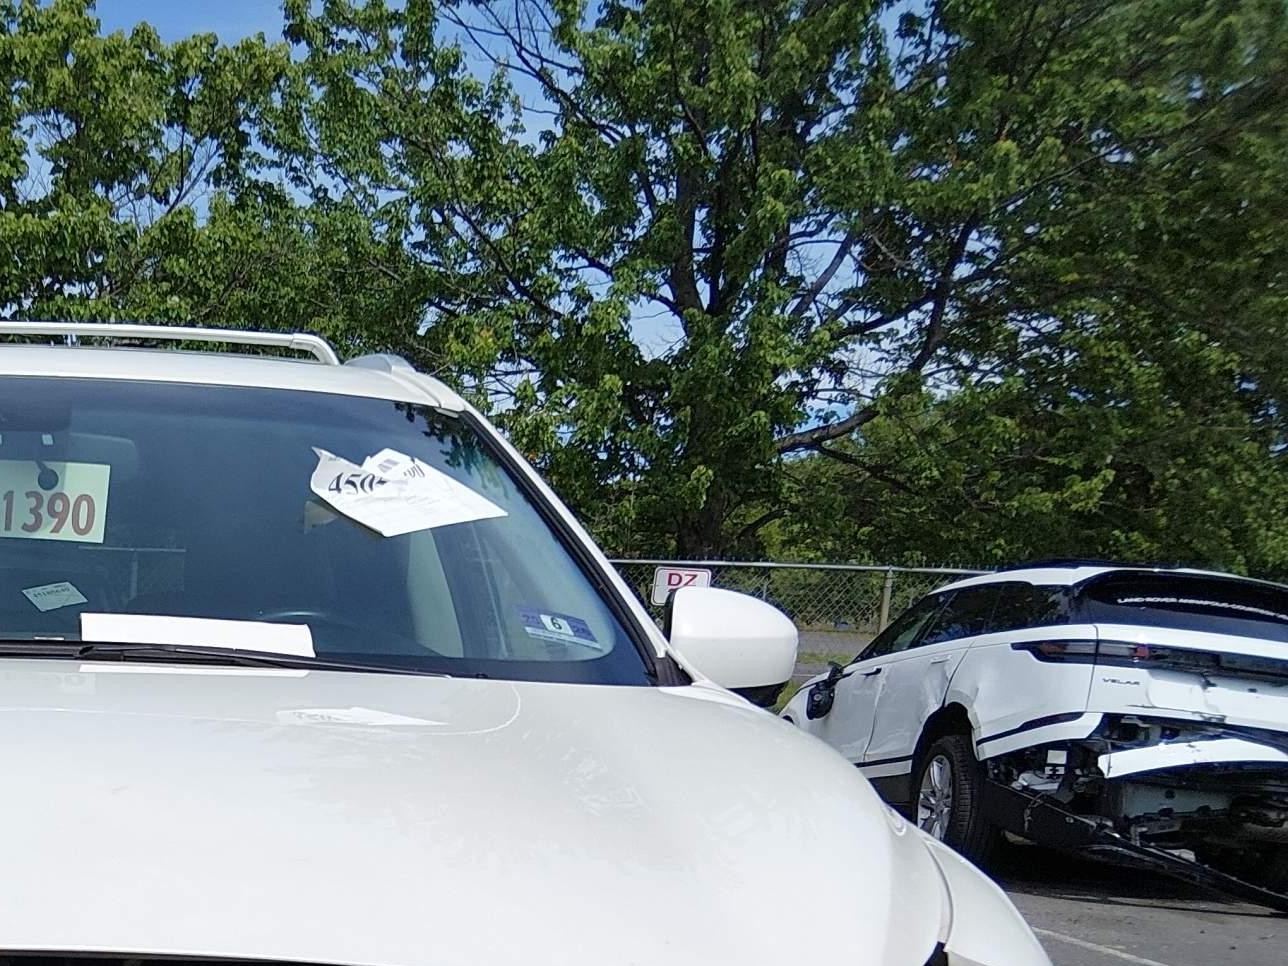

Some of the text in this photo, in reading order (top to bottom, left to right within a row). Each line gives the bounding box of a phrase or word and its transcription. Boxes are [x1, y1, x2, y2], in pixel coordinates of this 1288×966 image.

[2, 490, 96, 536] 1390
[667, 572, 698, 587] DZ
[550, 616, 563, 630] 6
